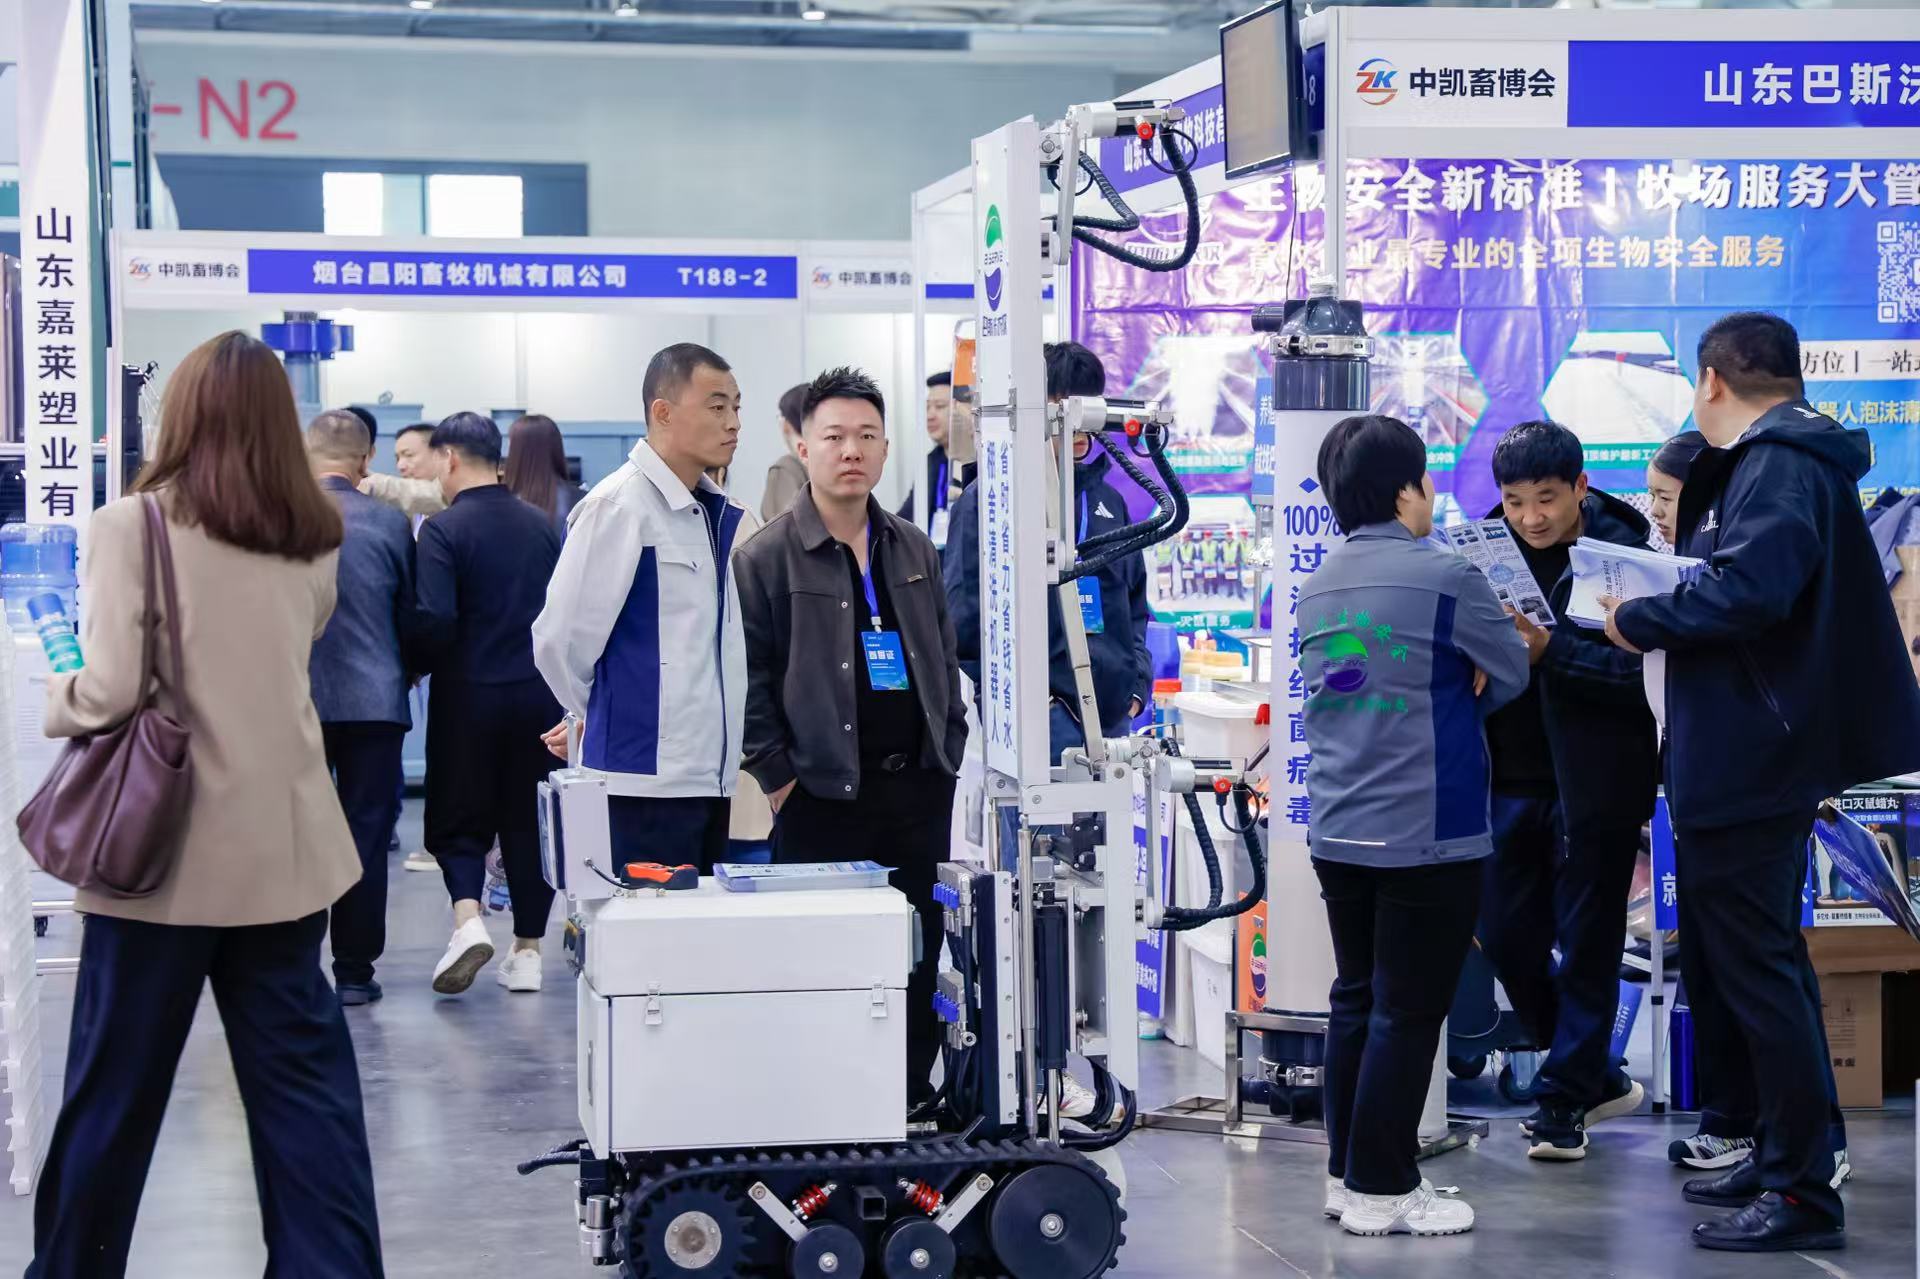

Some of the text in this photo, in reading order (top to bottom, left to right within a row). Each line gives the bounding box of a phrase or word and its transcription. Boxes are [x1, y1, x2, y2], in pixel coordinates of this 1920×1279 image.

[1409, 67, 1555, 97] 中凯畜博会
[158, 262, 241, 280] 中凯畜博会
[312, 259, 768, 289] 烟台昌阳畜牧机械有限公司 T188-2
[838, 271, 913, 286] 中凯畜博会
[36, 207, 79, 517] 山东嘉莱塑业有
[1811, 401, 1920, 425] 器人泡沫清
[1283, 505, 1340, 537] 100%
